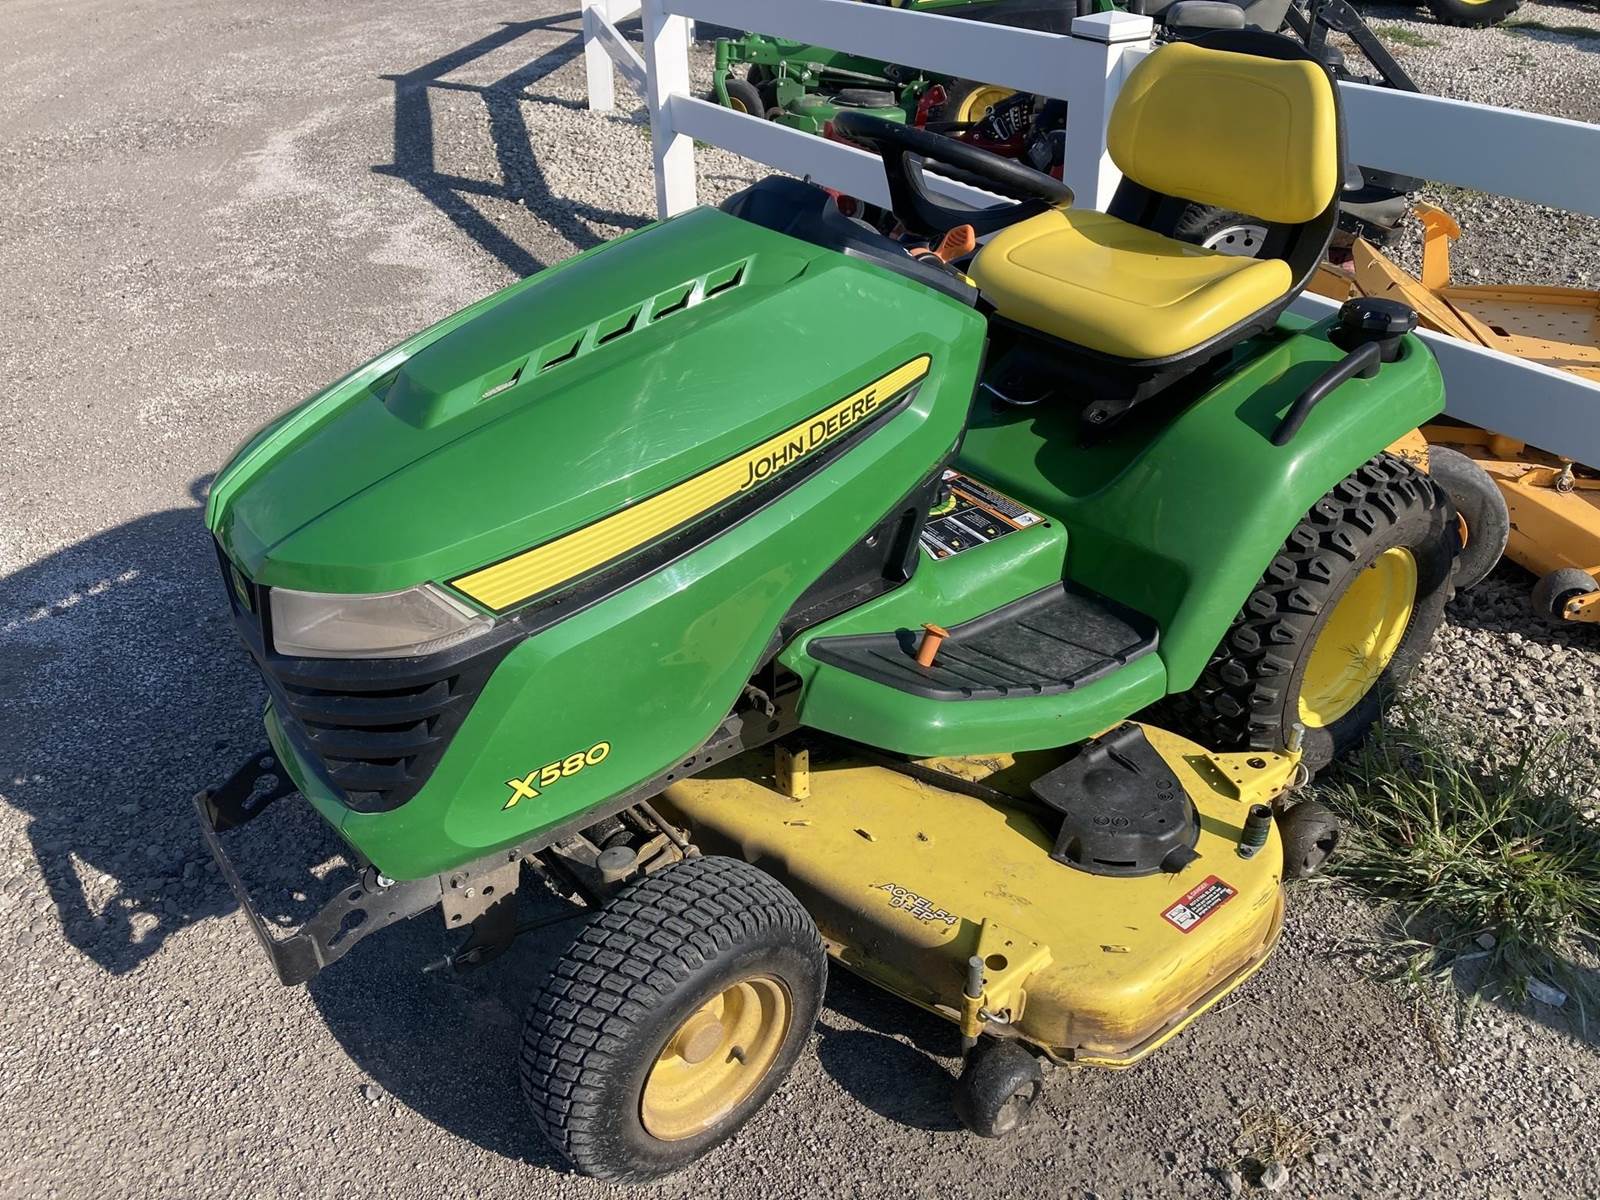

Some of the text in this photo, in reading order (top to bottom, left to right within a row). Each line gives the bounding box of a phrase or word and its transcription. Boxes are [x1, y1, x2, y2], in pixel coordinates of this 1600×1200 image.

[740, 388, 877, 490] JOHN DEERE
[502, 740, 611, 811] X580
[888, 896, 935, 921] DEEP
[932, 908, 959, 925] 54
